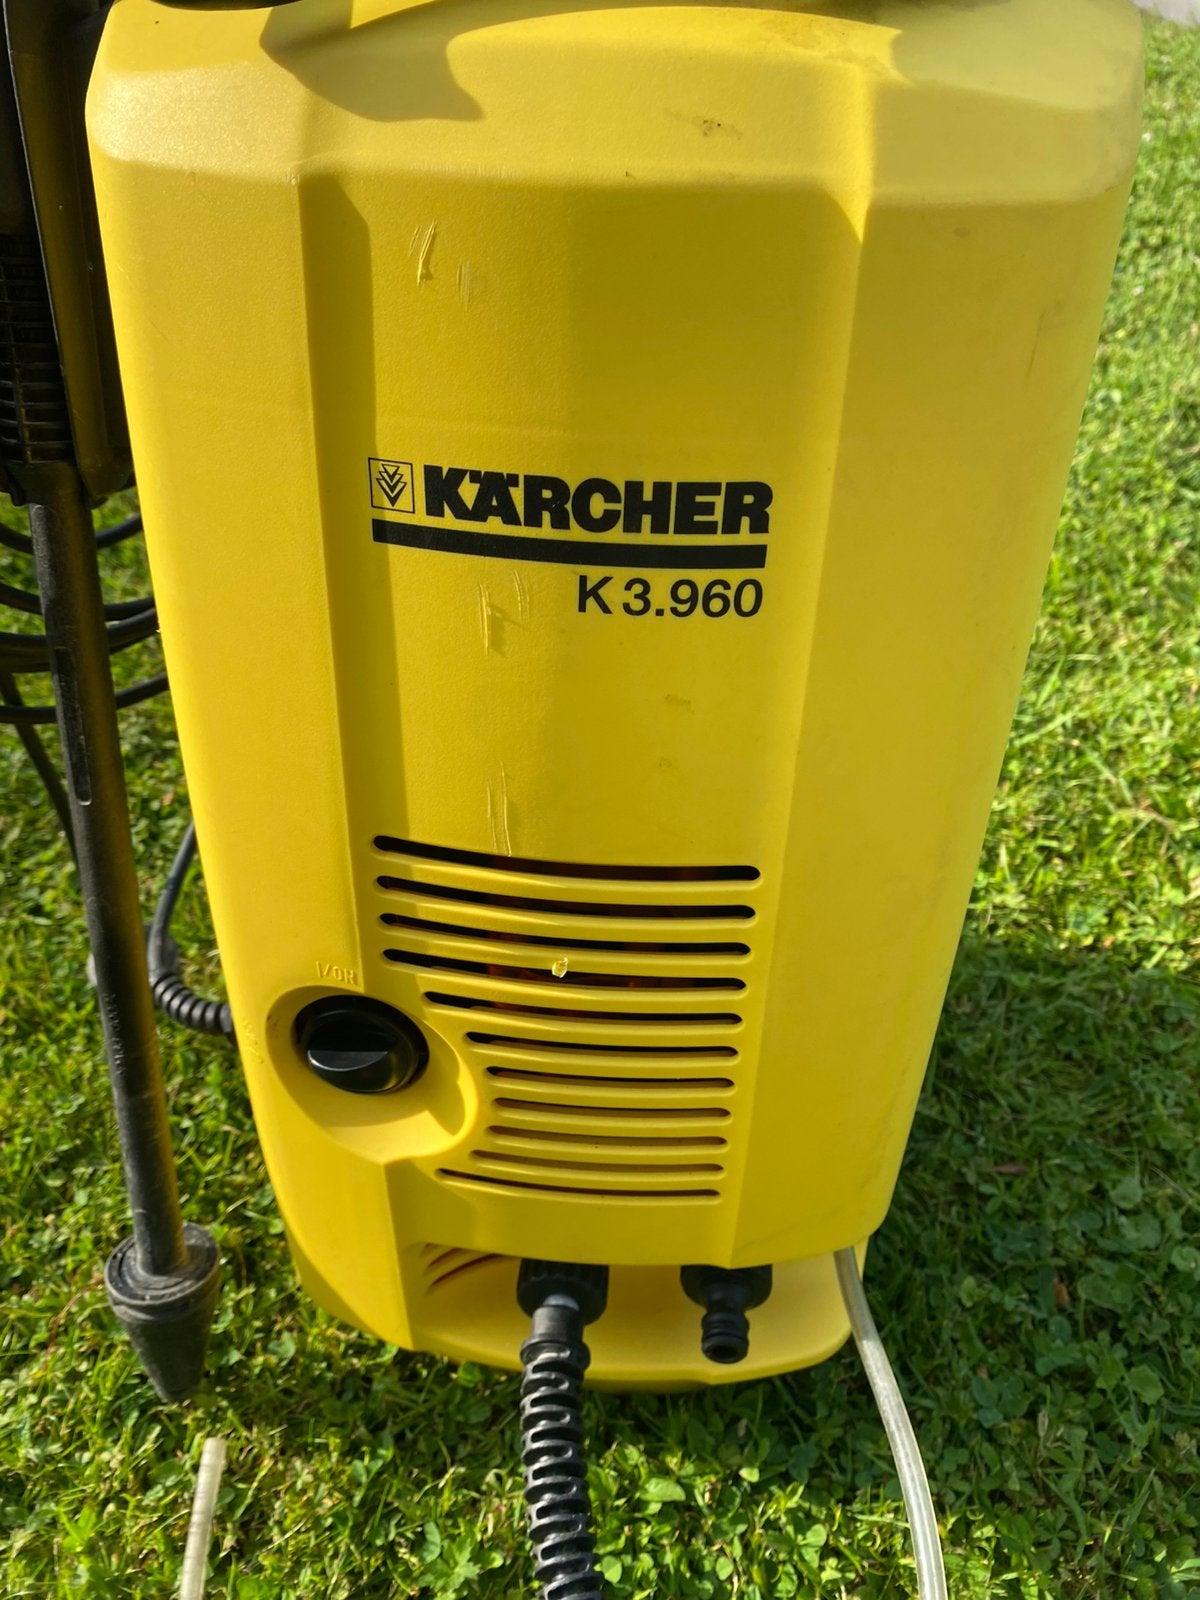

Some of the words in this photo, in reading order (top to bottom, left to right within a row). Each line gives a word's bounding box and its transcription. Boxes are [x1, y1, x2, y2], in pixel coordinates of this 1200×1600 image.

[424, 464, 773, 534] KÄRCHER
[578, 575, 613, 614] K
[622, 578, 763, 617] 3.960
